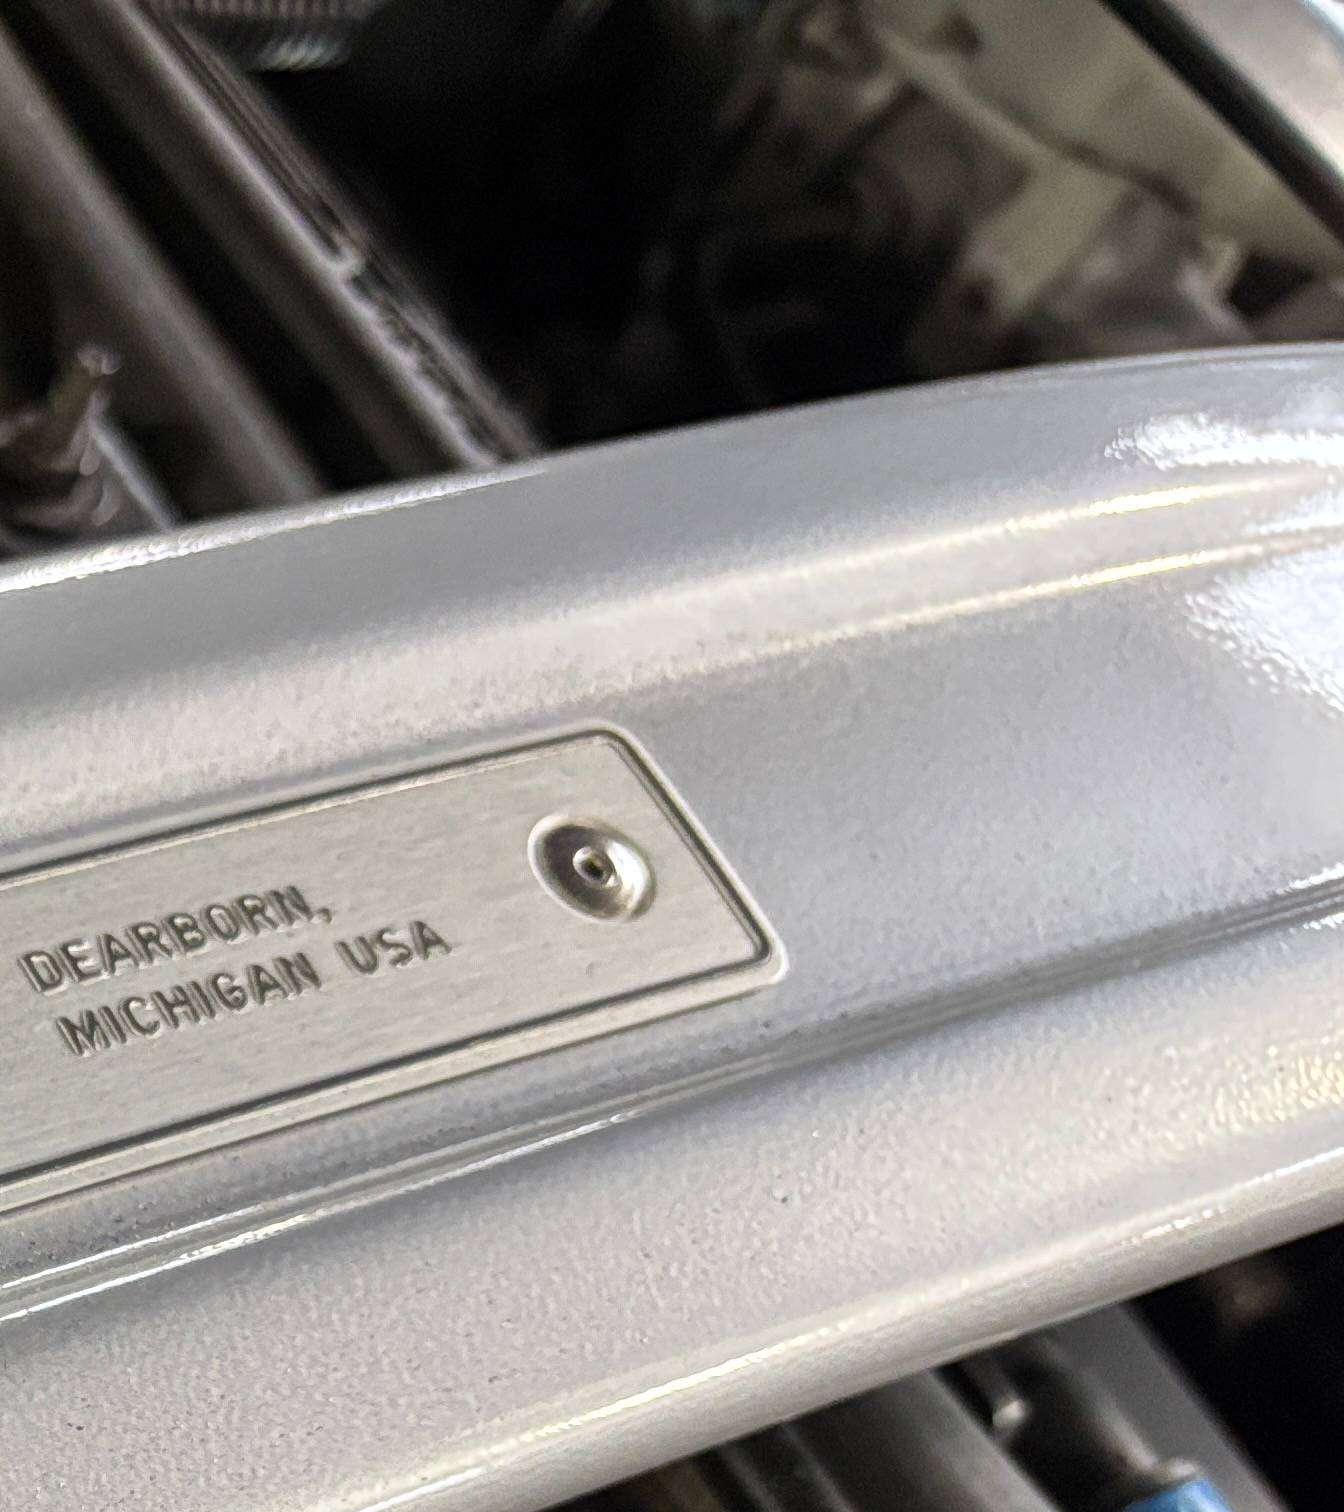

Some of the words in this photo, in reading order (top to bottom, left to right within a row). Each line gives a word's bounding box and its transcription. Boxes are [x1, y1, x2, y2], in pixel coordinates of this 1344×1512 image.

[17, 885, 332, 996] DEARBORN,
[54, 951, 322, 1056] MICHIGAN
[336, 919, 453, 976] USA
